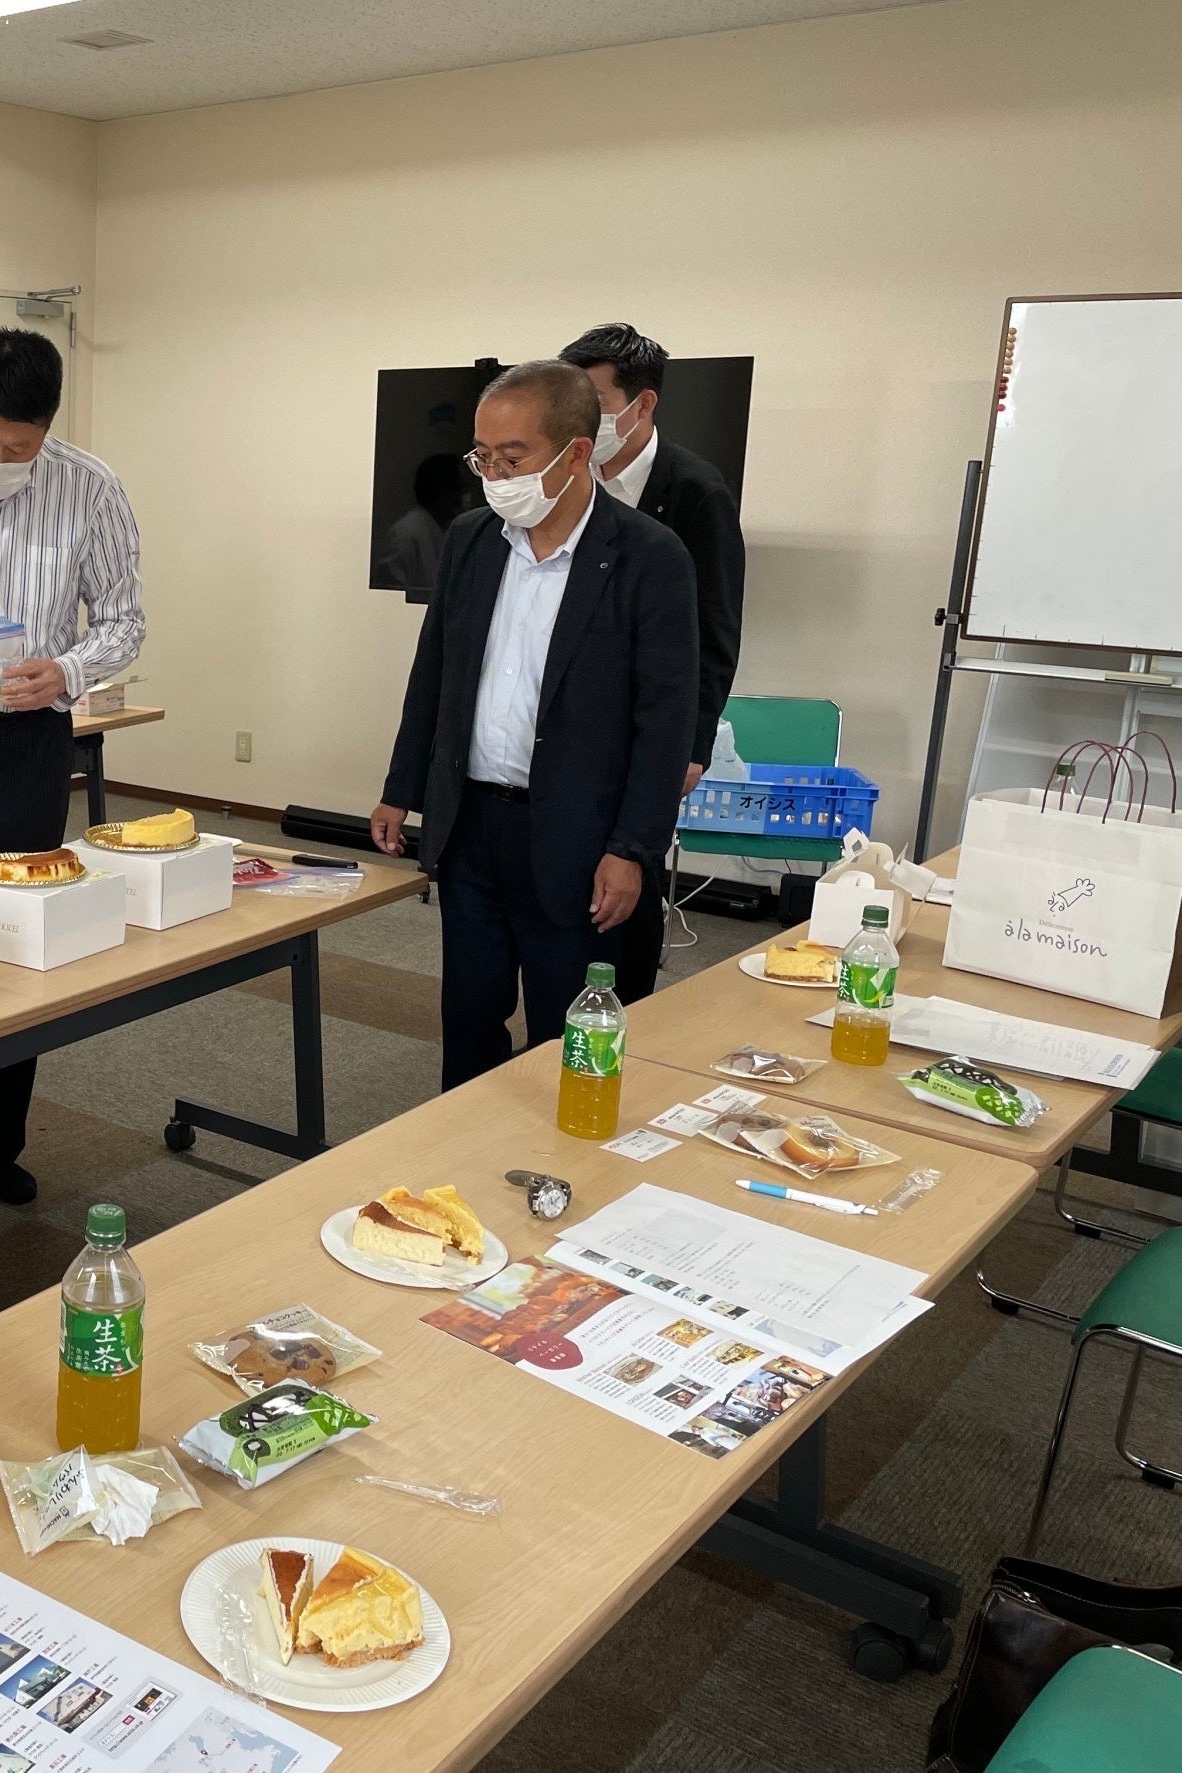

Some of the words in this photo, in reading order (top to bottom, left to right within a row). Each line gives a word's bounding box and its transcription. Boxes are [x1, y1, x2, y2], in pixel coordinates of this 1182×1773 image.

[739, 796, 796, 811] オイシス
[1037, 932, 1108, 957] maison
[569, 1031, 588, 1069] 生茶
[92, 1319, 122, 1372] 生茶
